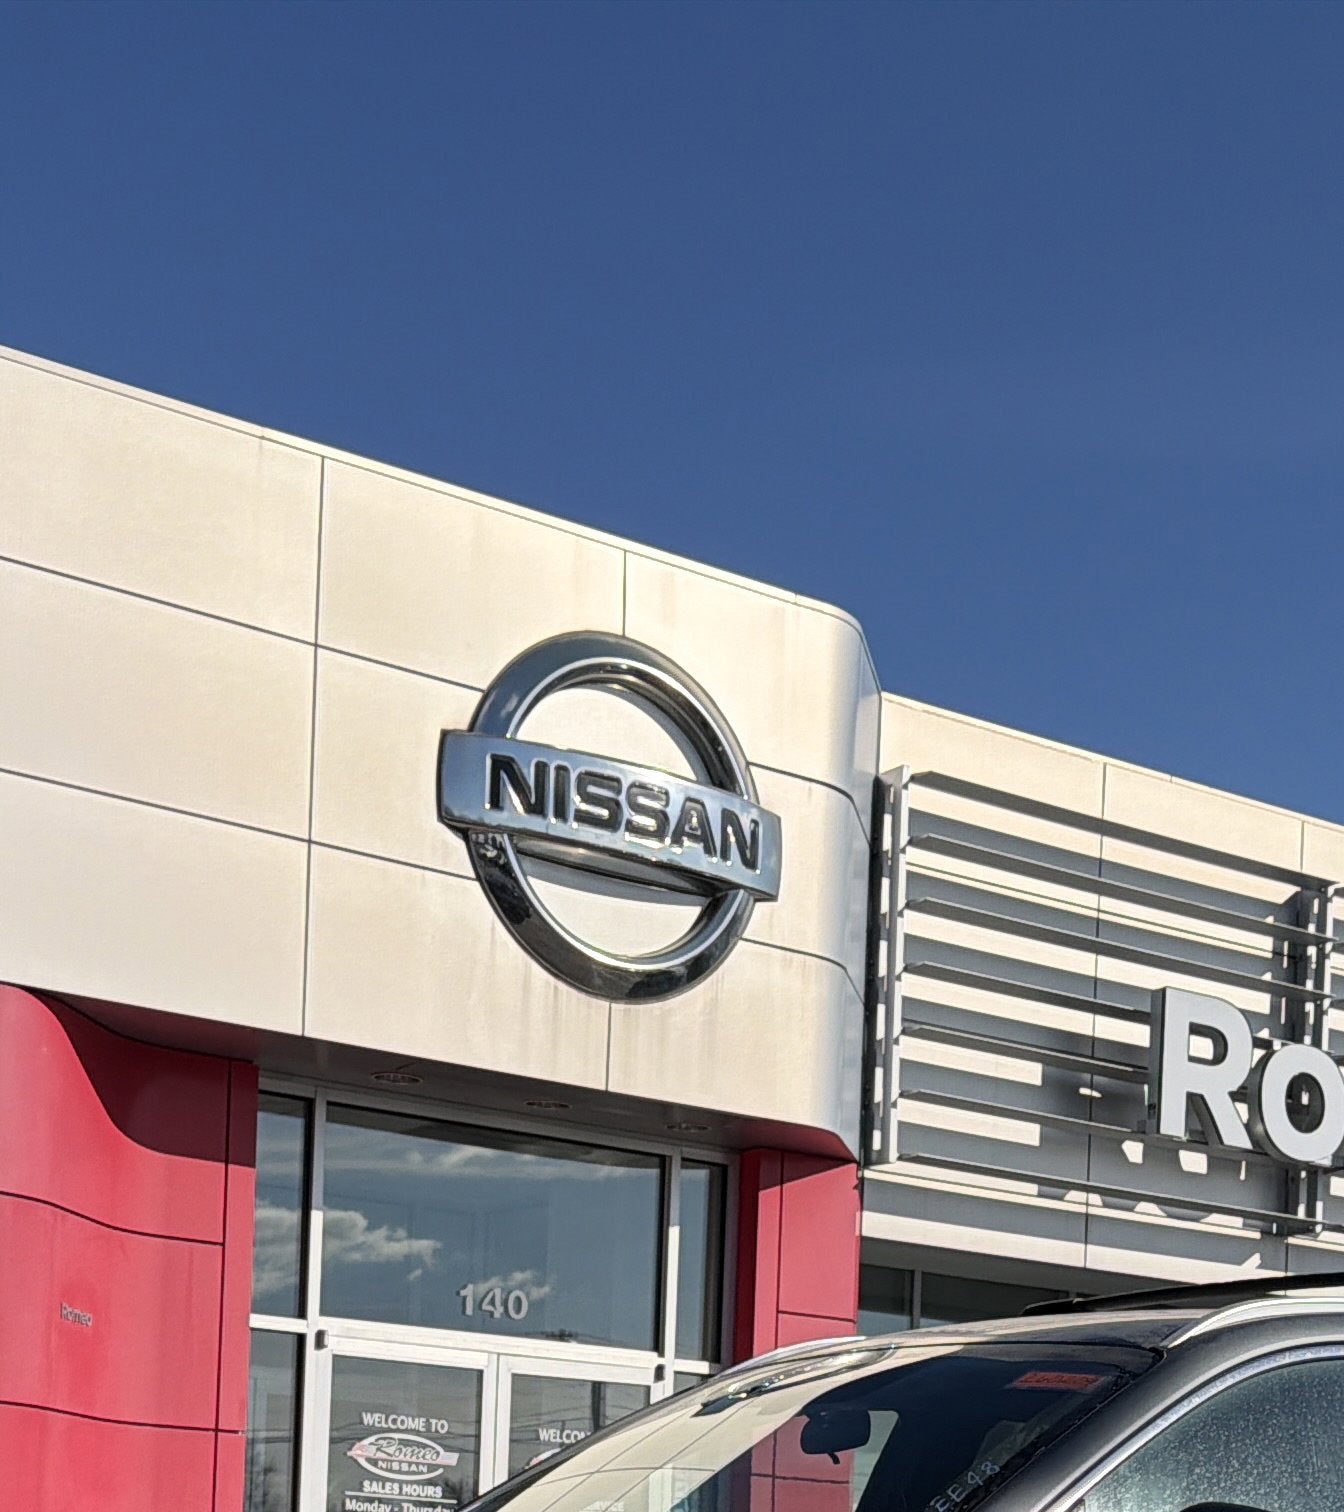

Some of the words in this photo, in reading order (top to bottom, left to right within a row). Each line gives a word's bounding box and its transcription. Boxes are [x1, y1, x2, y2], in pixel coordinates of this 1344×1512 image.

[485, 752, 762, 874] NISSAN
[458, 1284, 529, 1320] 140
[362, 1412, 426, 1432] WELCOME
[429, 1418, 449, 1434] TO
[377, 1460, 428, 1473] NISSAN
[363, 1480, 399, 1495] SALES
[402, 1483, 443, 1498] HOURS
